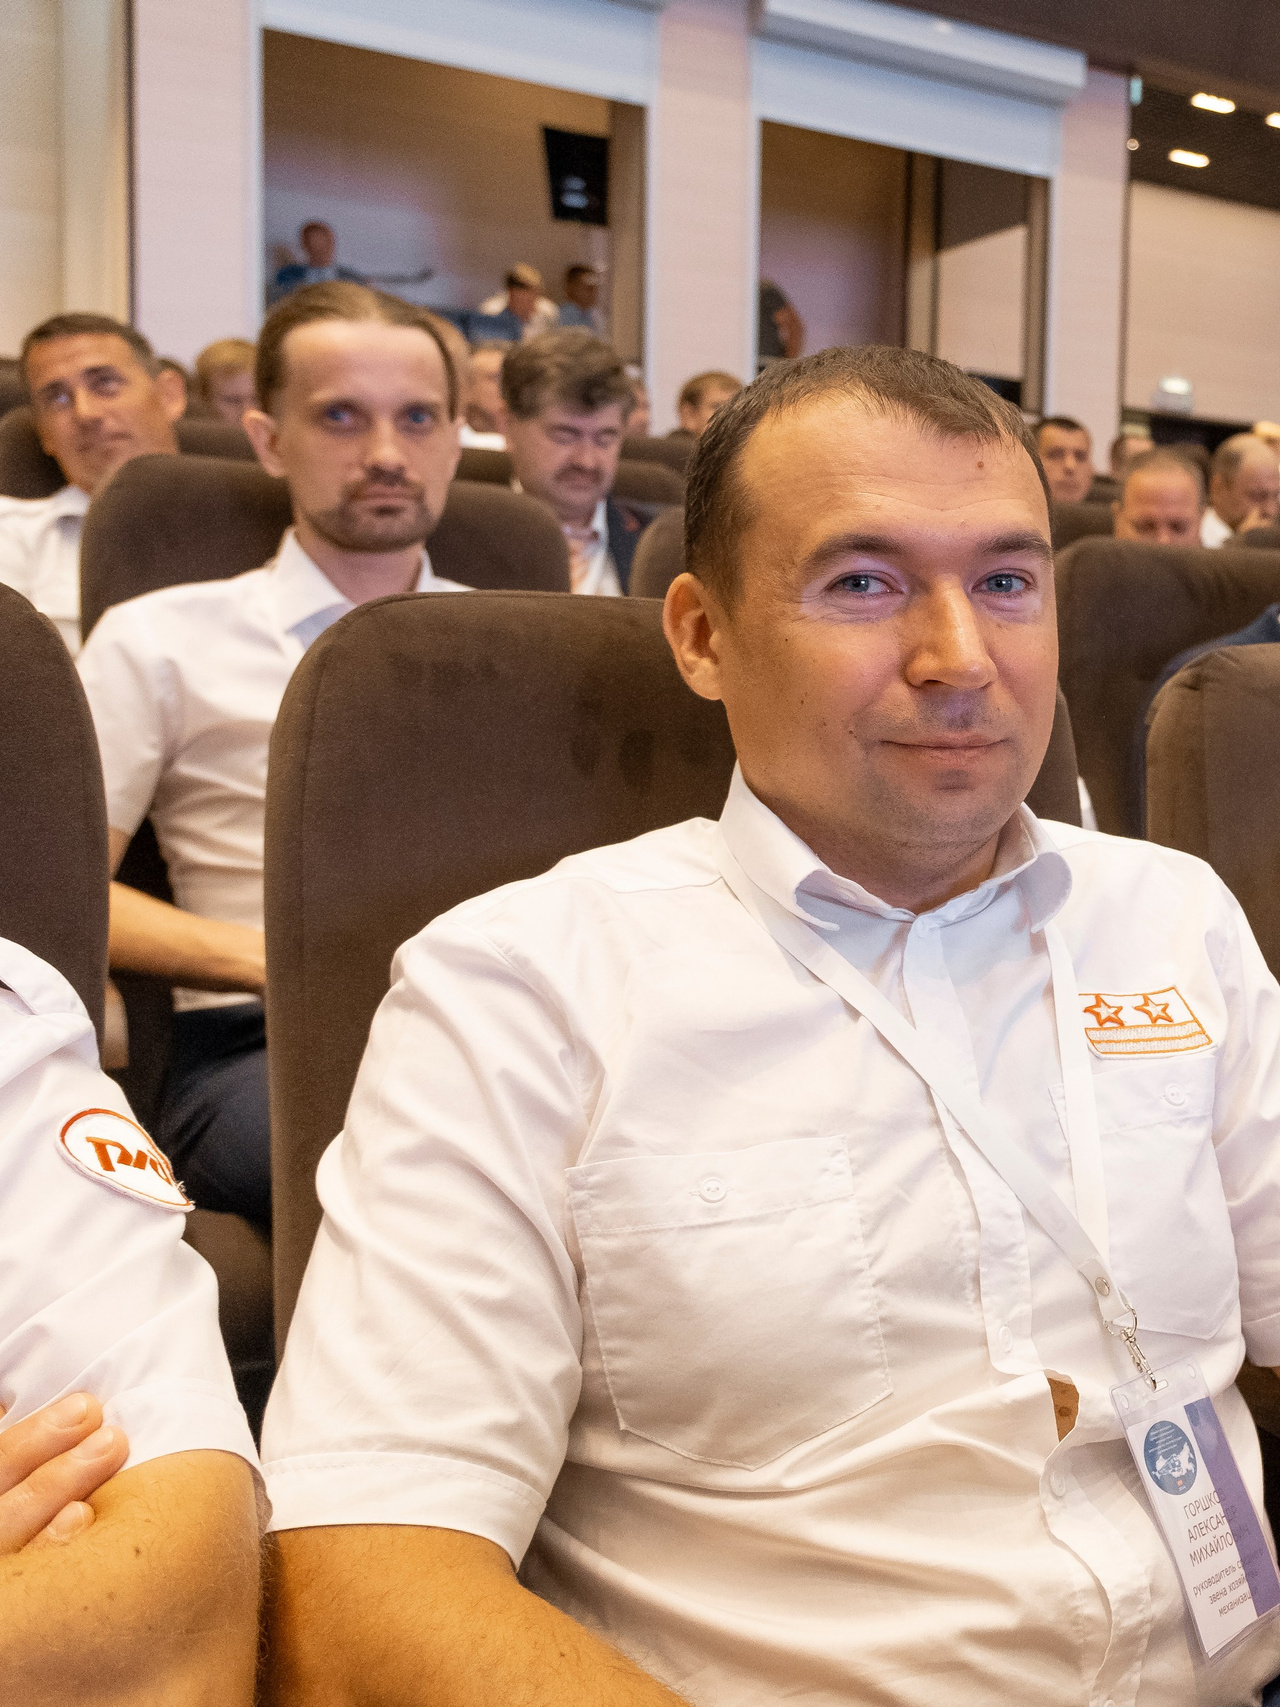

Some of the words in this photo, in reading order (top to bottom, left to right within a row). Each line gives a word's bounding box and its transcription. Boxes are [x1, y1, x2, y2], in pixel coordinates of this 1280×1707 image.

[1183, 1488, 1226, 1519] ГОРШКОВ
[1187, 1505, 1238, 1543] АЛЕКСАНДР
[1192, 1564, 1237, 1598] руководитель
